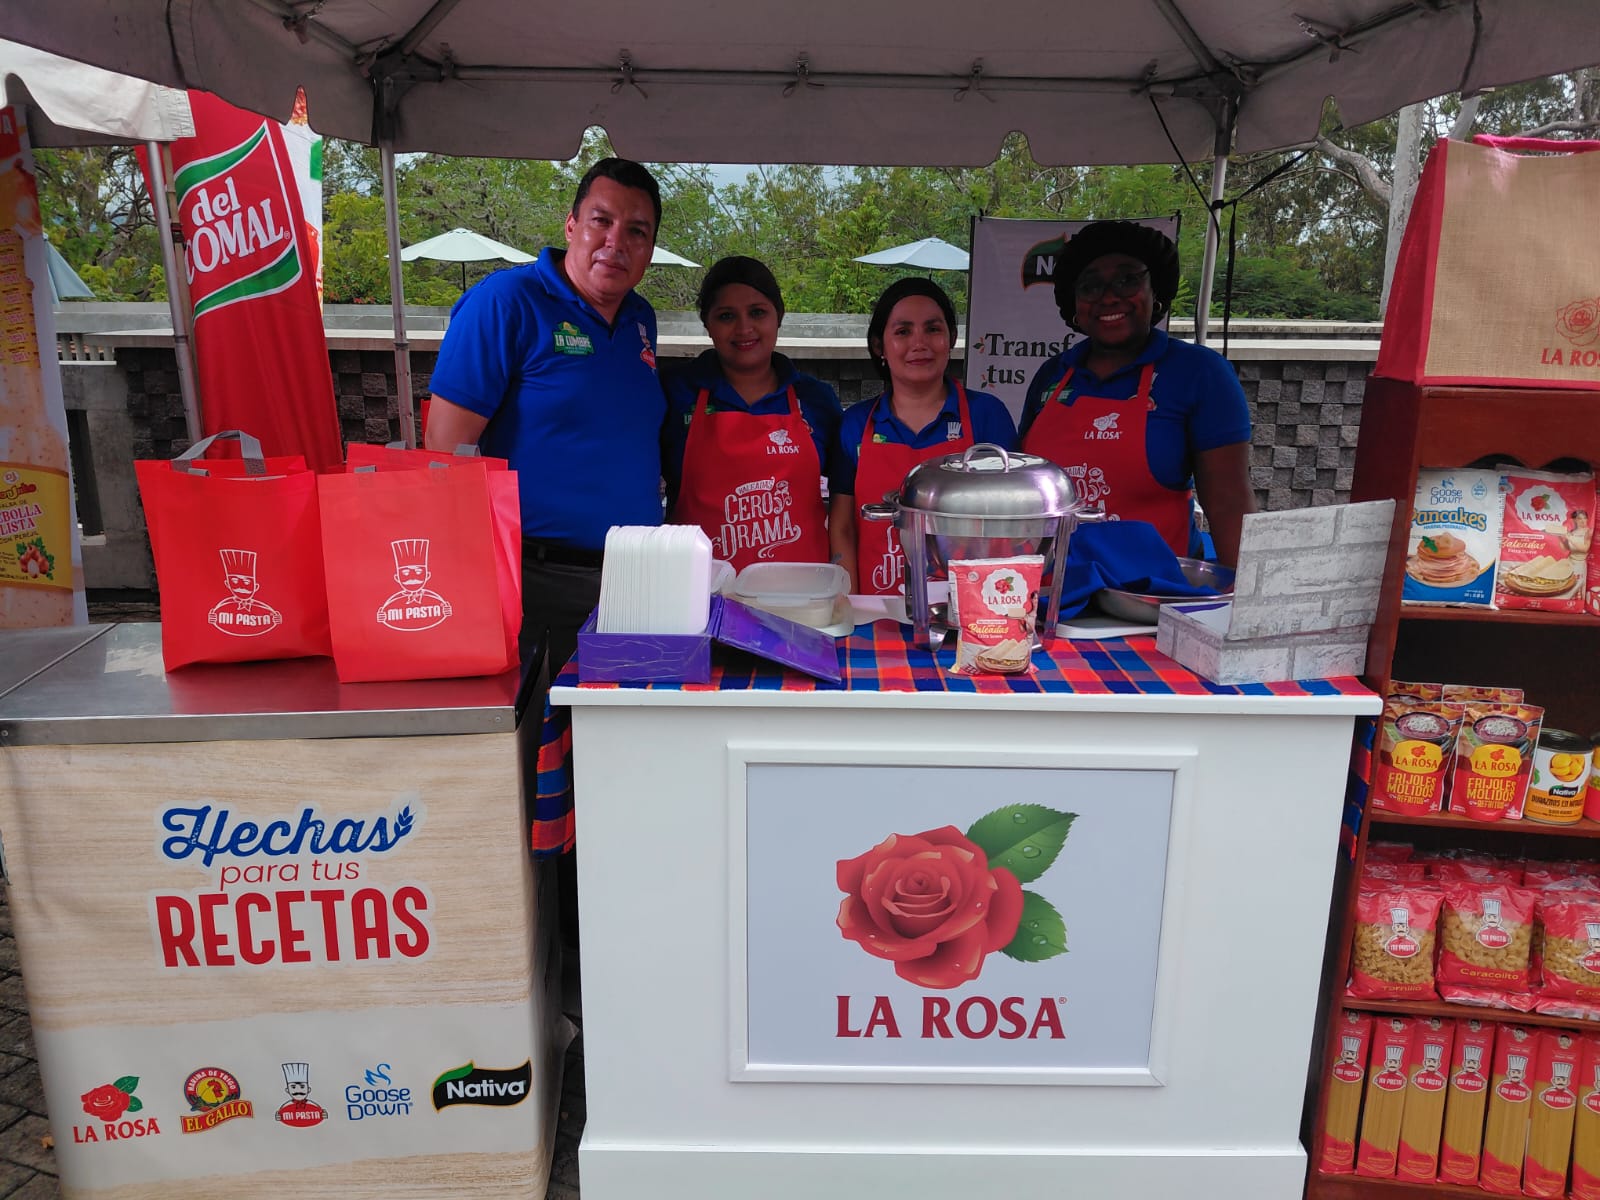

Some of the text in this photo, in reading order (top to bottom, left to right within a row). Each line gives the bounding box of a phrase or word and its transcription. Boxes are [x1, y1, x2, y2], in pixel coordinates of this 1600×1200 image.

[191, 176, 241, 226] del
[985, 333, 1076, 357] Transf
[1541, 347, 1600, 368] LA RO
[987, 364, 1026, 385] tus
[1084, 431, 1121, 440] LA ROSA
[766, 445, 799, 455] LA ROSA
[0, 504, 42, 524] BOLLA
[1521, 512, 1561, 522] LA ROSA
[988, 595, 1022, 605] LA ROSA
[218, 612, 271, 626] MI PASTA
[388, 605, 441, 621] MI PASTA
[1395, 756, 1438, 769] LA ROSA
[1474, 760, 1517, 771] LA ROSA
[1389, 772, 1437, 787] FRIJOLES
[1467, 777, 1517, 791] FRIJOLES
[1387, 783, 1435, 798] MOLIDOS
[1466, 788, 1515, 802] MOLIDOS
[162, 805, 402, 868] Hechas
[220, 859, 360, 891] para tus
[155, 886, 430, 968] RECETAS
[1460, 967, 1519, 980] Caracolito
[836, 995, 1066, 1039] LA ROSA
[219, 1072, 236, 1090] TRIGO
[446, 1079, 525, 1100] Nativa
[345, 1085, 411, 1103] Goose
[186, 1102, 249, 1131] EL GALLO
[283, 1110, 321, 1121] MI PASTA
[347, 1102, 410, 1121] Down
[73, 1117, 161, 1143] LA ROSA
